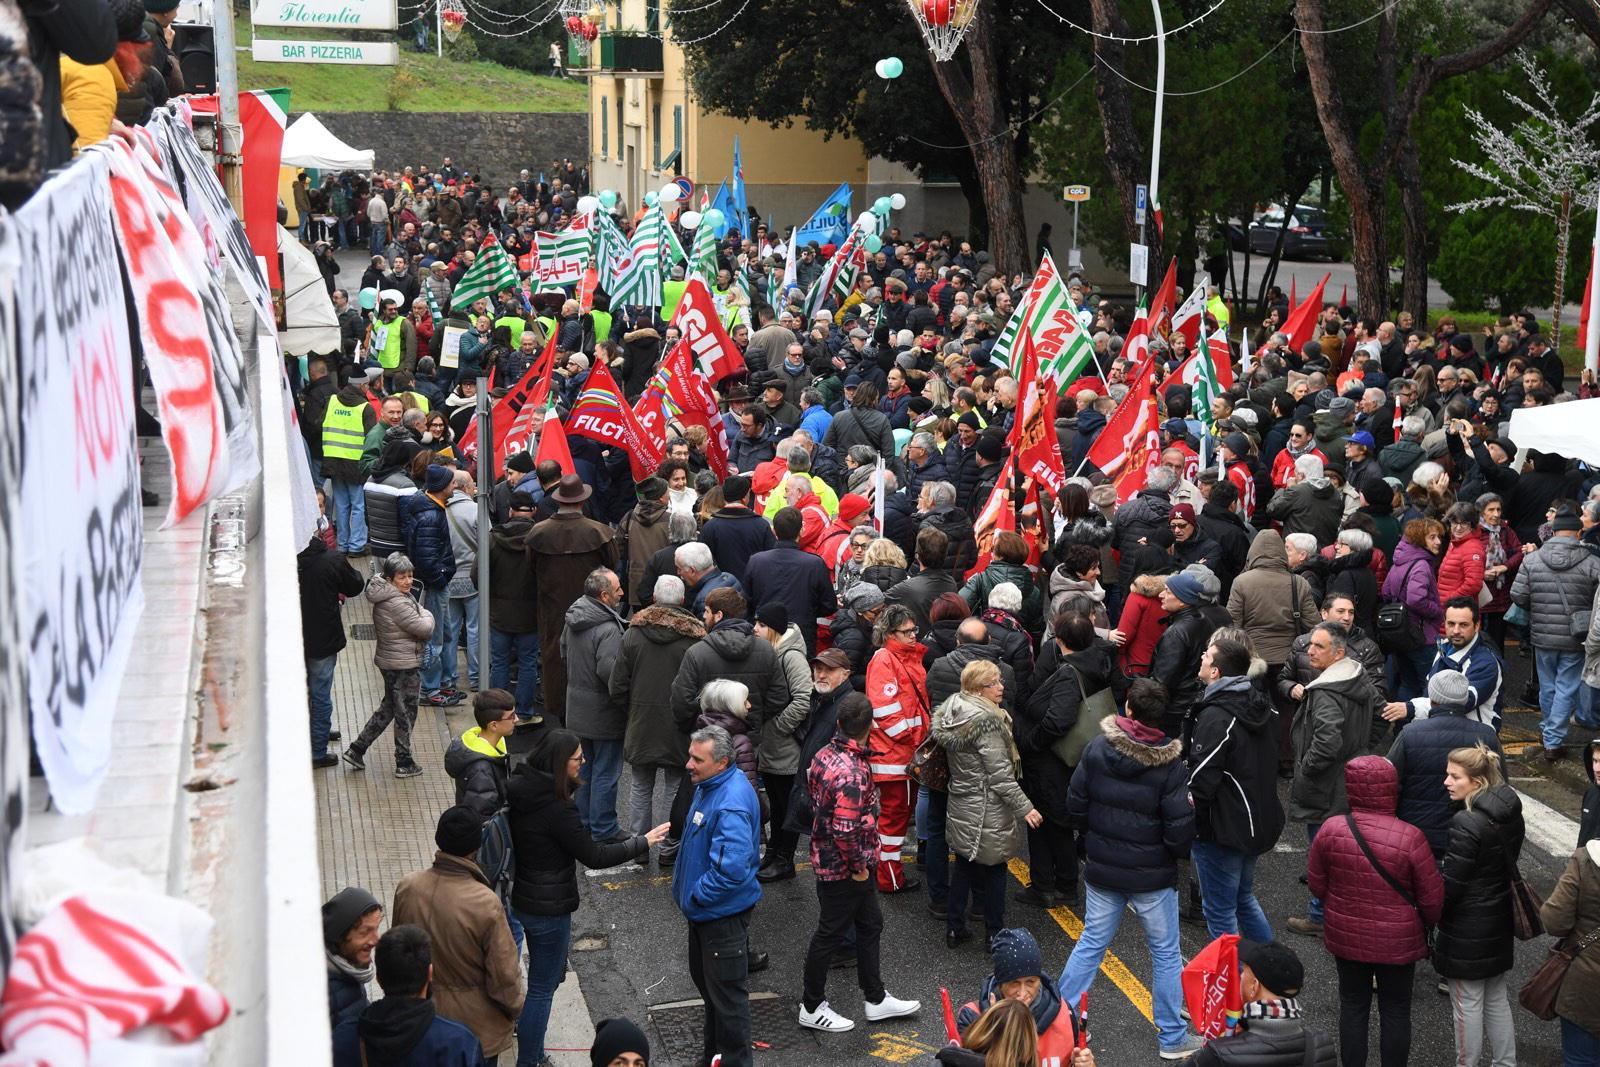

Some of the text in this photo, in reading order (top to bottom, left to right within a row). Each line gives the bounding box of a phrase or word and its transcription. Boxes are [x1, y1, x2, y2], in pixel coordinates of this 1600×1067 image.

[280, 3, 361, 24] Florentia
[282, 45, 363, 60] BAR PIZZERIA
